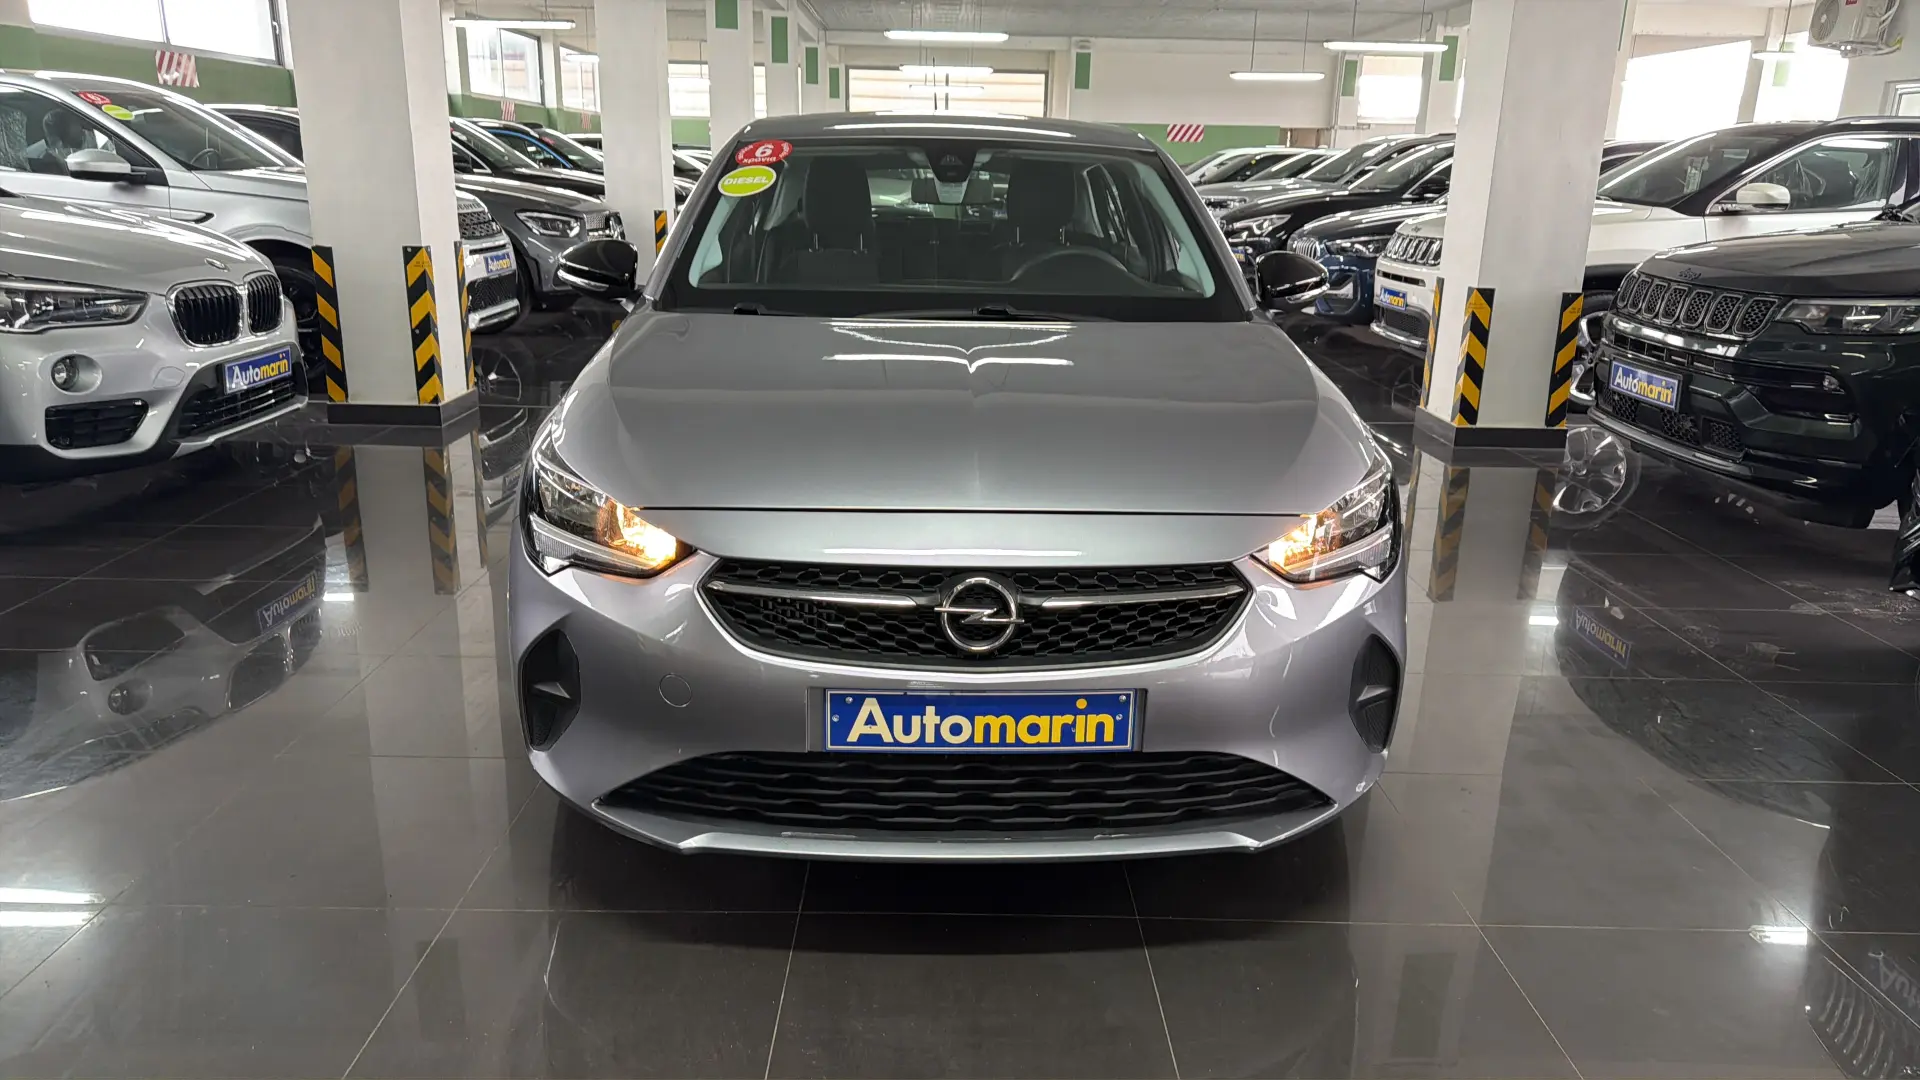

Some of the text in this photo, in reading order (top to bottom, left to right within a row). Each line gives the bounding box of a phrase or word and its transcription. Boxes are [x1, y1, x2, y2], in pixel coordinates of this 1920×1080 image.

[755, 143, 774, 158] 6
[724, 176, 769, 186] DIESEL
[231, 353, 289, 389] Automarin
[1614, 366, 1672, 404] Automarin
[846, 697, 1115, 744] Automarin
